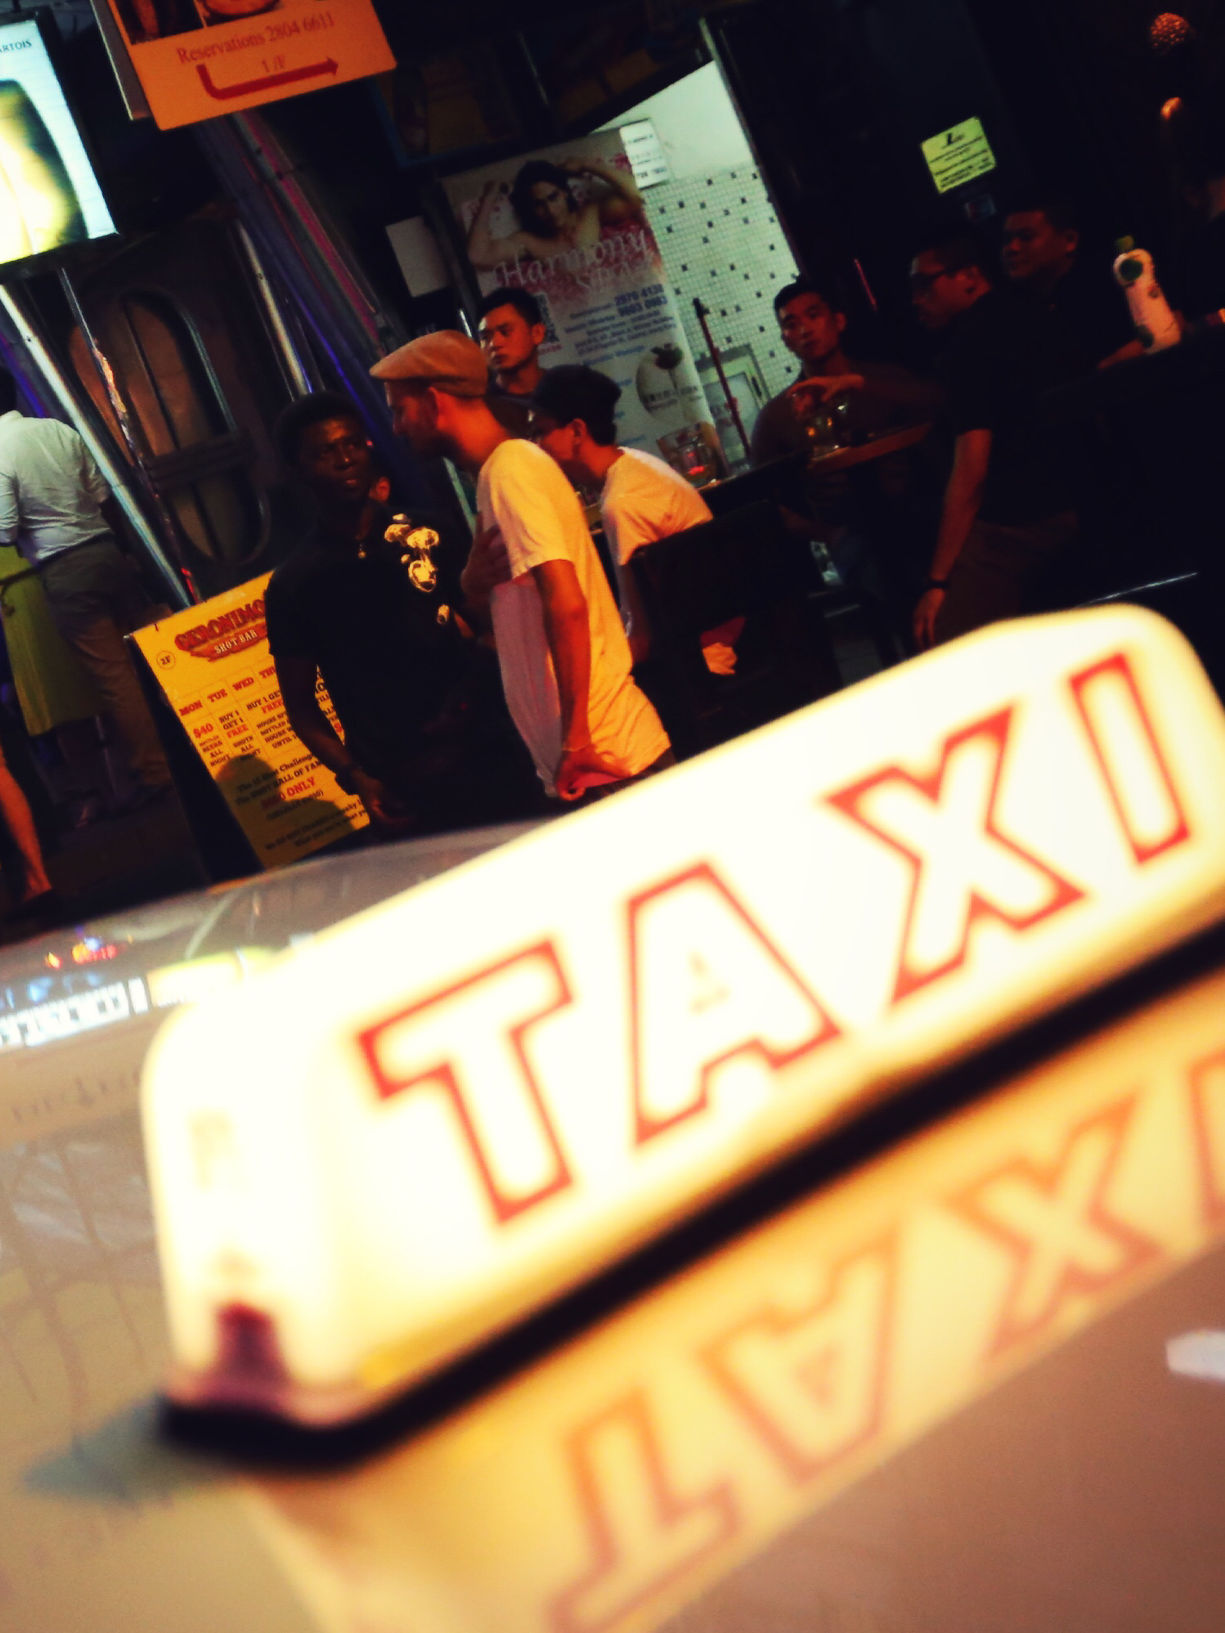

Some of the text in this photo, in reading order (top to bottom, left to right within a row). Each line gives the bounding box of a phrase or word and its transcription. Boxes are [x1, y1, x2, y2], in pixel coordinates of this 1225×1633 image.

[176, 33, 265, 64] Reservations
[302, 11, 335, 31] 6611
[179, 700, 204, 717] MON
[207, 688, 229, 703] TUE
[232, 676, 255, 691] WED
[246, 699, 263, 712] BUY
[219, 712, 234, 724] BUY
[223, 719, 238, 731] GET
[193, 722, 214, 740] $40
[226, 724, 249, 740] FREE
[294, 767, 305, 779] OF
[286, 776, 316, 797] ONLY
[358, 652, 1191, 1225] TAXI
